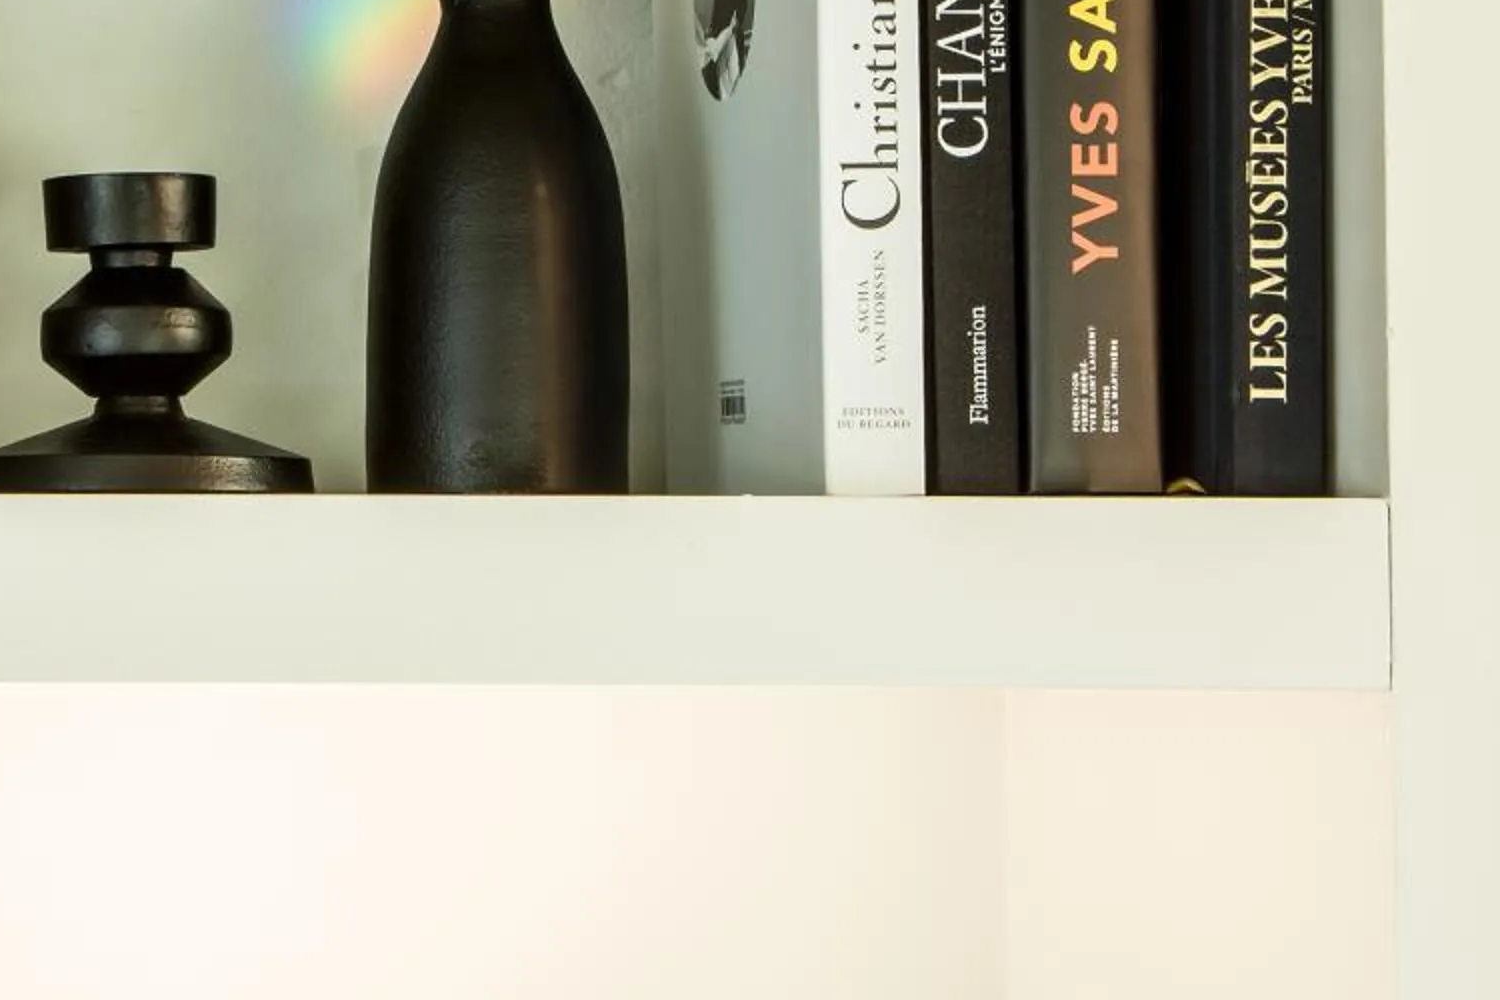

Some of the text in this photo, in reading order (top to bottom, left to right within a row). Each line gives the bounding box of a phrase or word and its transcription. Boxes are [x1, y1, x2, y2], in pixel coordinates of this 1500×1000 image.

[1292, 28, 1314, 105] PARIS
[1069, 101, 1120, 276] YVES
[1245, 97, 1289, 301] MUSÉES
[856, 279, 869, 335] SACHA
[1249, 311, 1288, 405] LES
[968, 304, 988, 426] Flammarion
